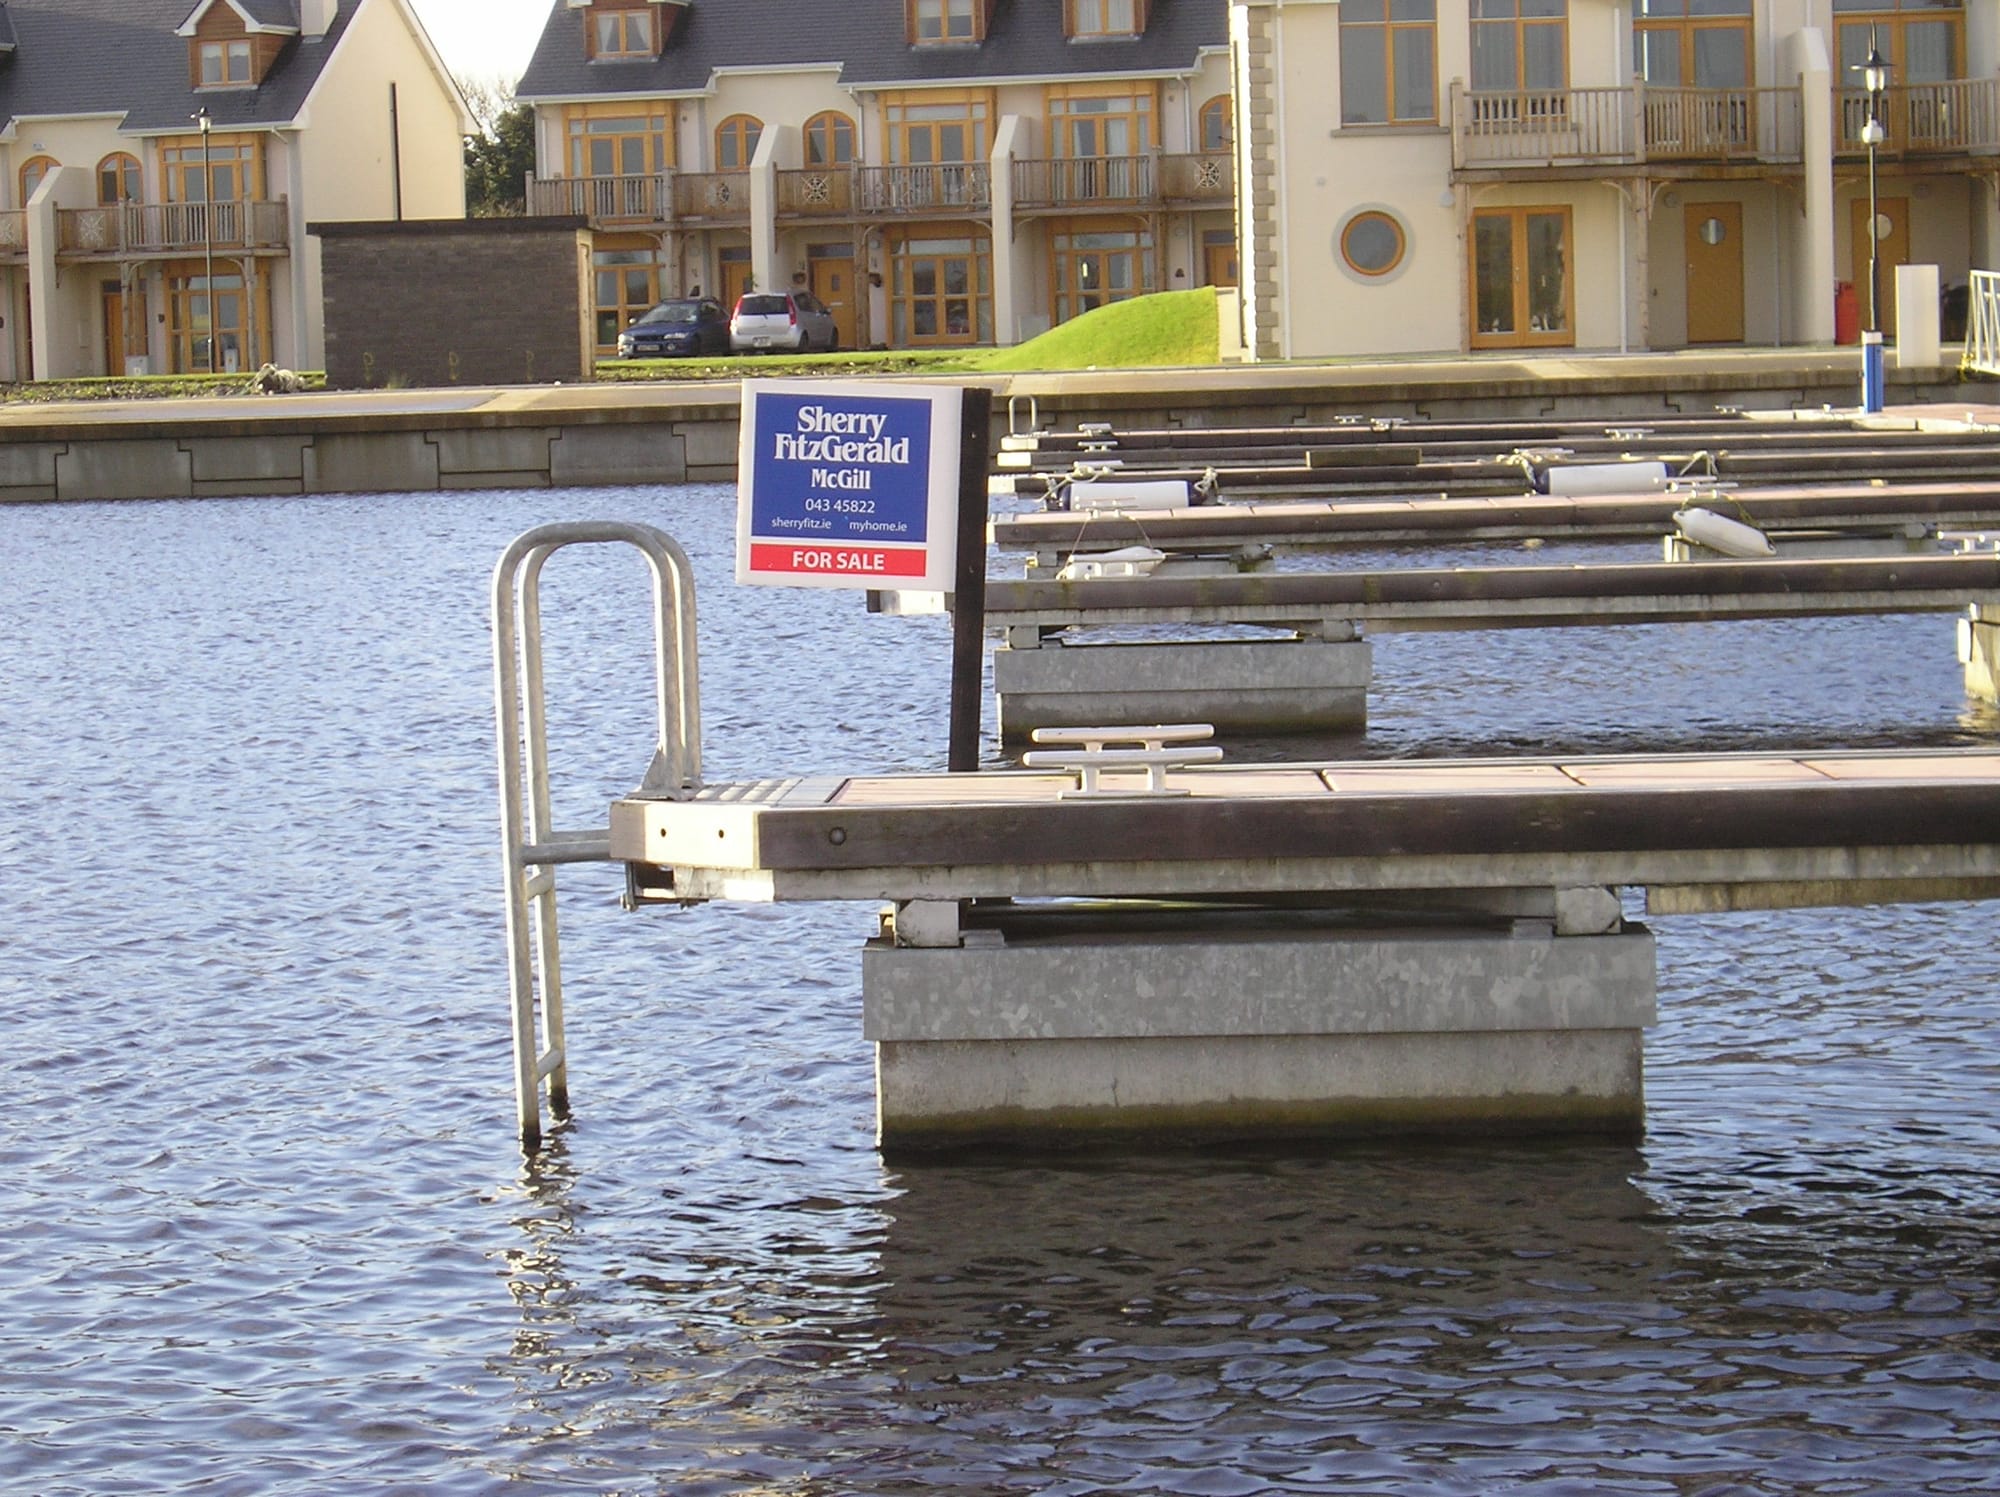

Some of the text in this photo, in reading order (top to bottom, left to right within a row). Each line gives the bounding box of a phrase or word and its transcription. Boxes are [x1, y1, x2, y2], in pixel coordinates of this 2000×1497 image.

[797, 406, 887, 441] Sherry
[774, 433, 909, 464] FitzGerald
[811, 468, 871, 489] McGill
[805, 498, 875, 514] 043 45822
[771, 517, 832, 530] sherryfitz.ie
[849, 520, 908, 533] myhome.ie
[792, 551, 885, 571] FOR SALE
